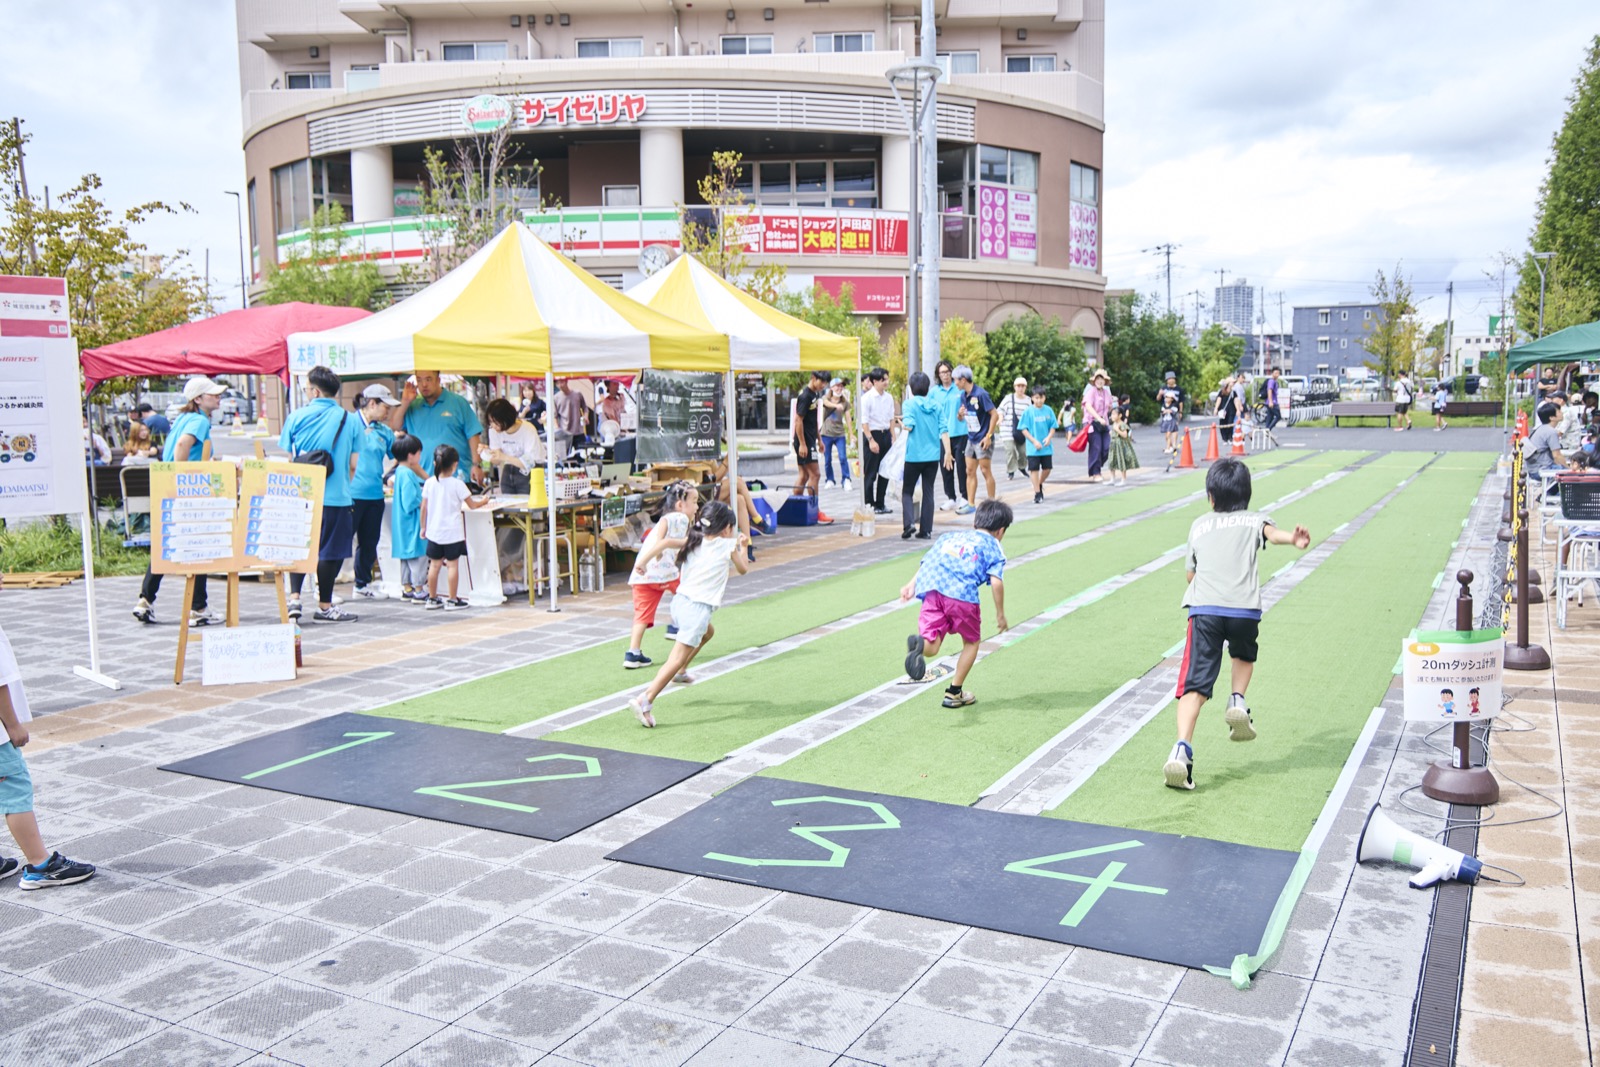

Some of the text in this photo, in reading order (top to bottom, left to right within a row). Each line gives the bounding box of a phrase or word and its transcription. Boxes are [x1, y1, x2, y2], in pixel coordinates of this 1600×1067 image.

[522, 94, 645, 124] サイゼリヤ
[177, 473, 211, 486] RUN
[268, 473, 301, 487] RUN
[4, 484, 48, 493] DAIMATSU
[178, 486, 211, 497] KING
[268, 486, 299, 497] KING
[1216, 514, 1259, 530] MEXICO
[250, 533, 256, 542] 4
[1421, 657, 1496, 671] 20mダッシュ計測
[241, 731, 395, 780] 1
[414, 753, 602, 813] 2
[703, 795, 901, 868] 3
[1003, 839, 1169, 928] 4
